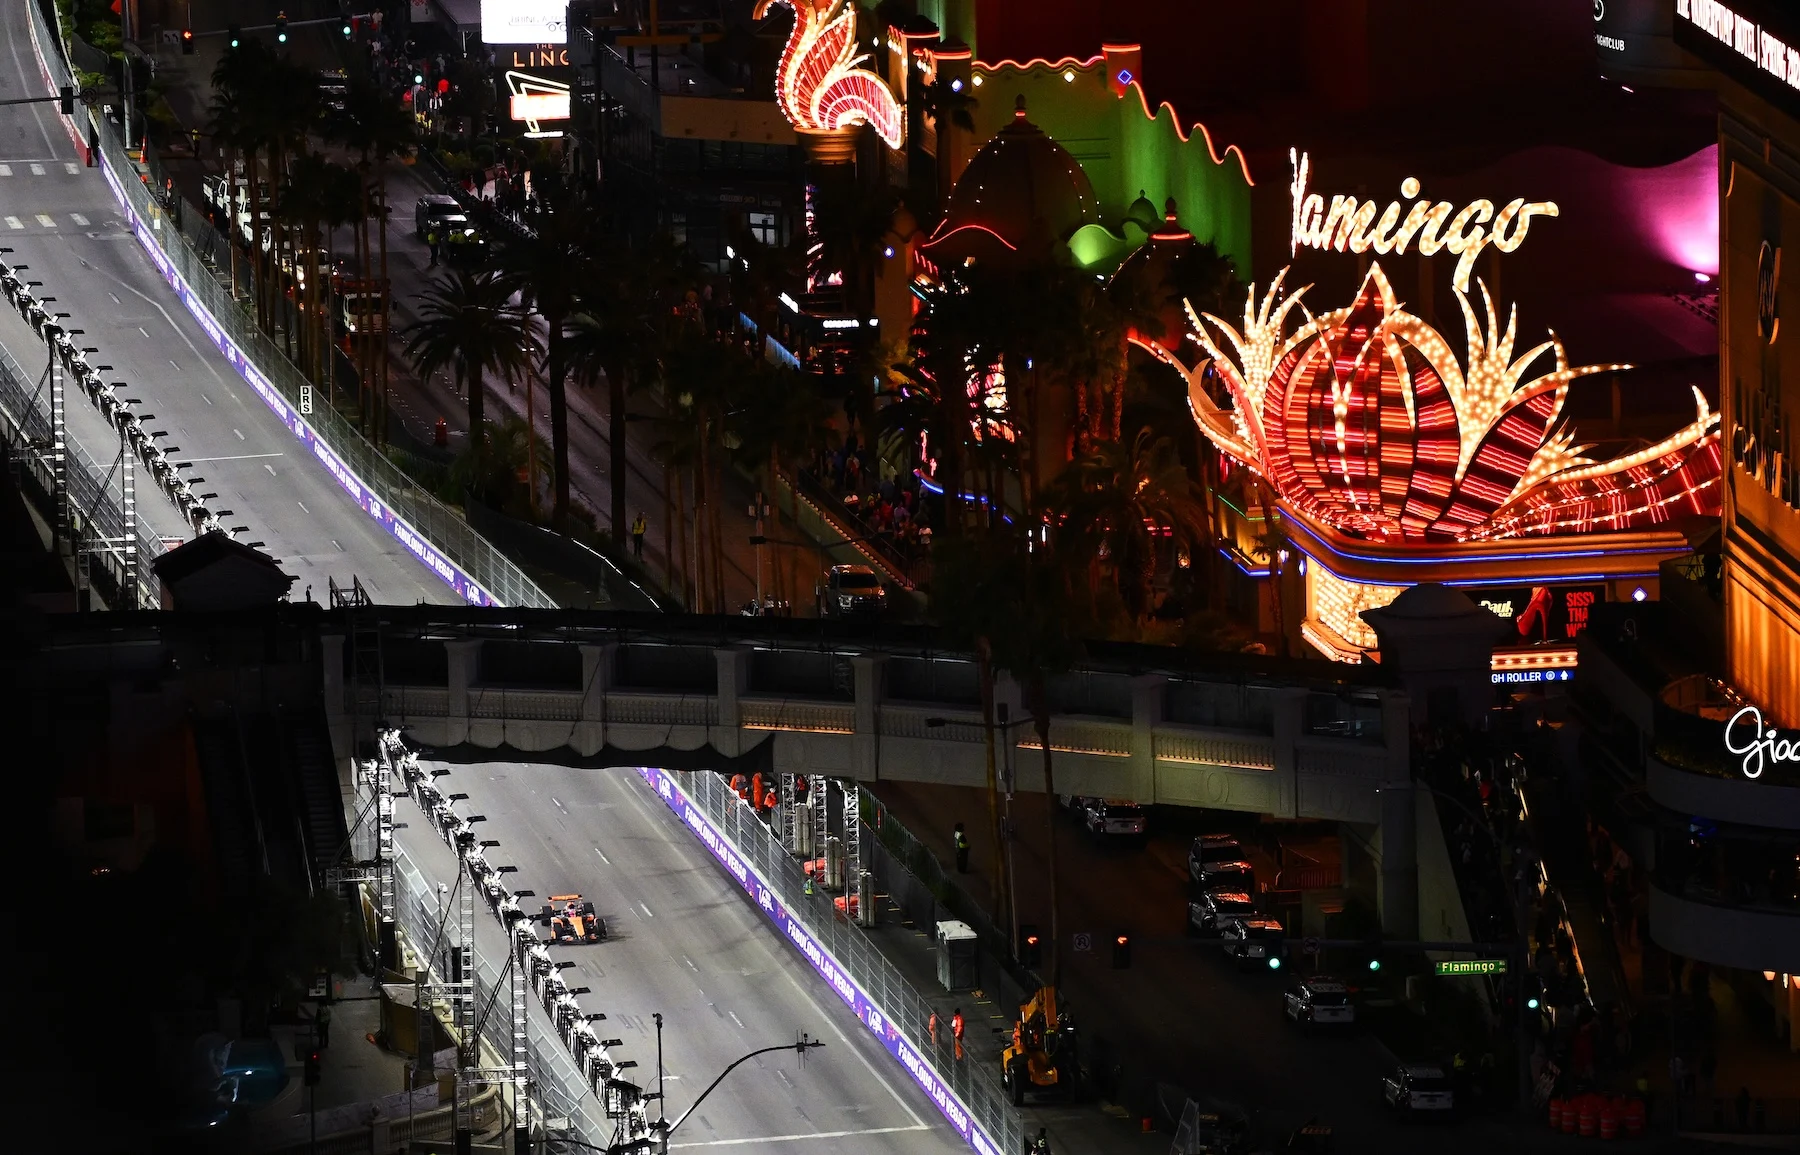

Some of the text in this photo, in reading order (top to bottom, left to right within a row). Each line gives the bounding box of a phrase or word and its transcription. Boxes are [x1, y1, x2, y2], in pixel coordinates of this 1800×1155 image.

[1735, 14, 1756, 62] HOTEL
[1761, 31, 1787, 81] SPRING
[302, 386, 310, 412] DRS
[394, 522, 454, 583] FABULOUS LAS VEGAS
[1491, 672, 1542, 683] GH ROLLER
[685, 805, 747, 883] FABULOUS LAS VEGAS
[788, 920, 855, 1003] FABULOUS LAS VEGAS
[1442, 962, 1495, 972] Flamingo
[898, 1042, 968, 1133] FABULOUS LAS VEGAS
